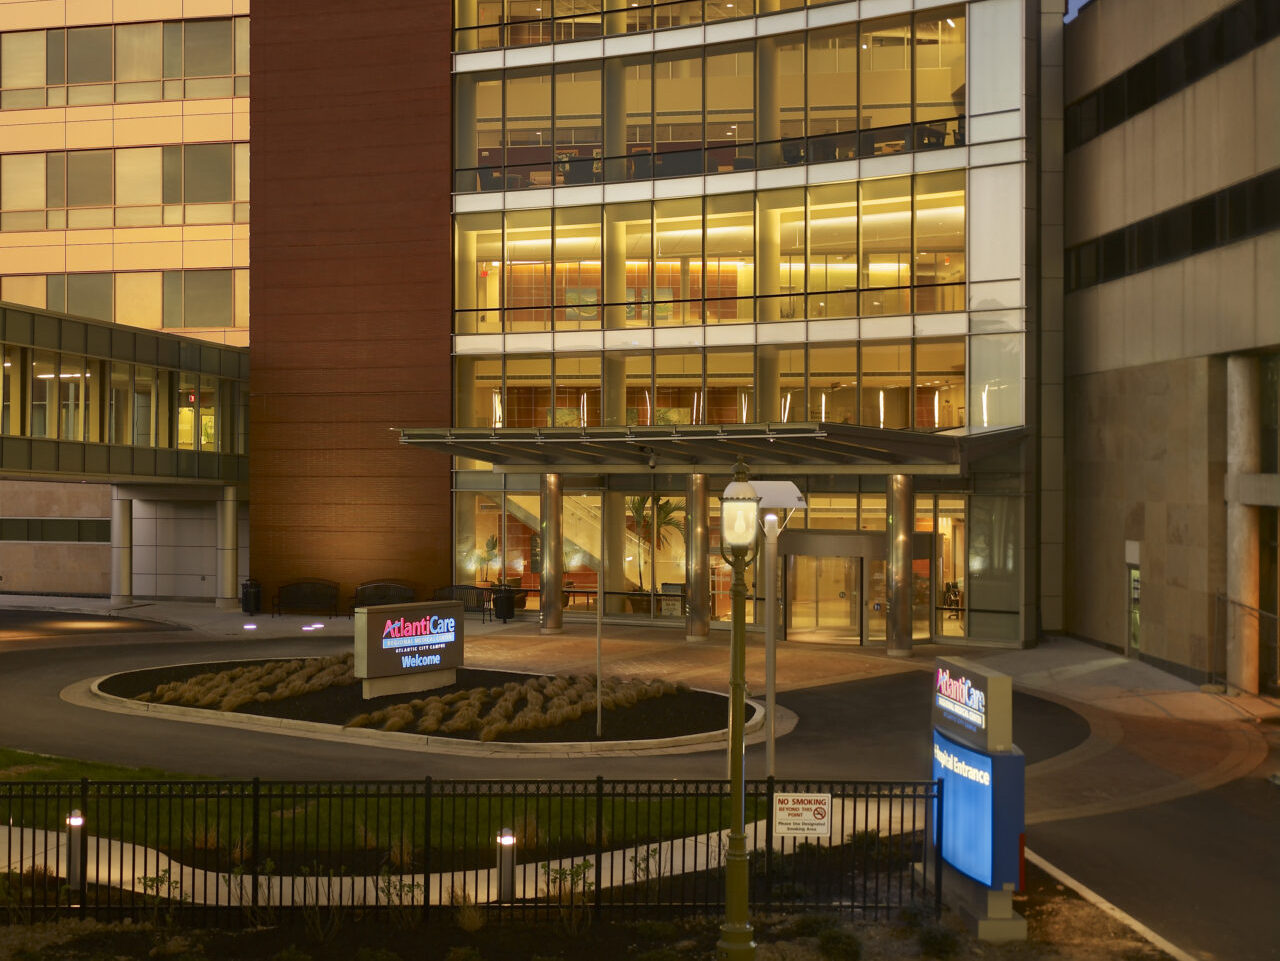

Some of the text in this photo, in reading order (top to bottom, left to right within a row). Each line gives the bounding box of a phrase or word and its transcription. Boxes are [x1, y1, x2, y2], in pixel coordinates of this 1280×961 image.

[383, 615, 455, 638] AtlantiCare
[401, 653, 440, 668] Welcome
[937, 668, 985, 713] AtlantiCare
[954, 758, 990, 786] Entrance
[777, 798, 827, 806] NO SMOKING
